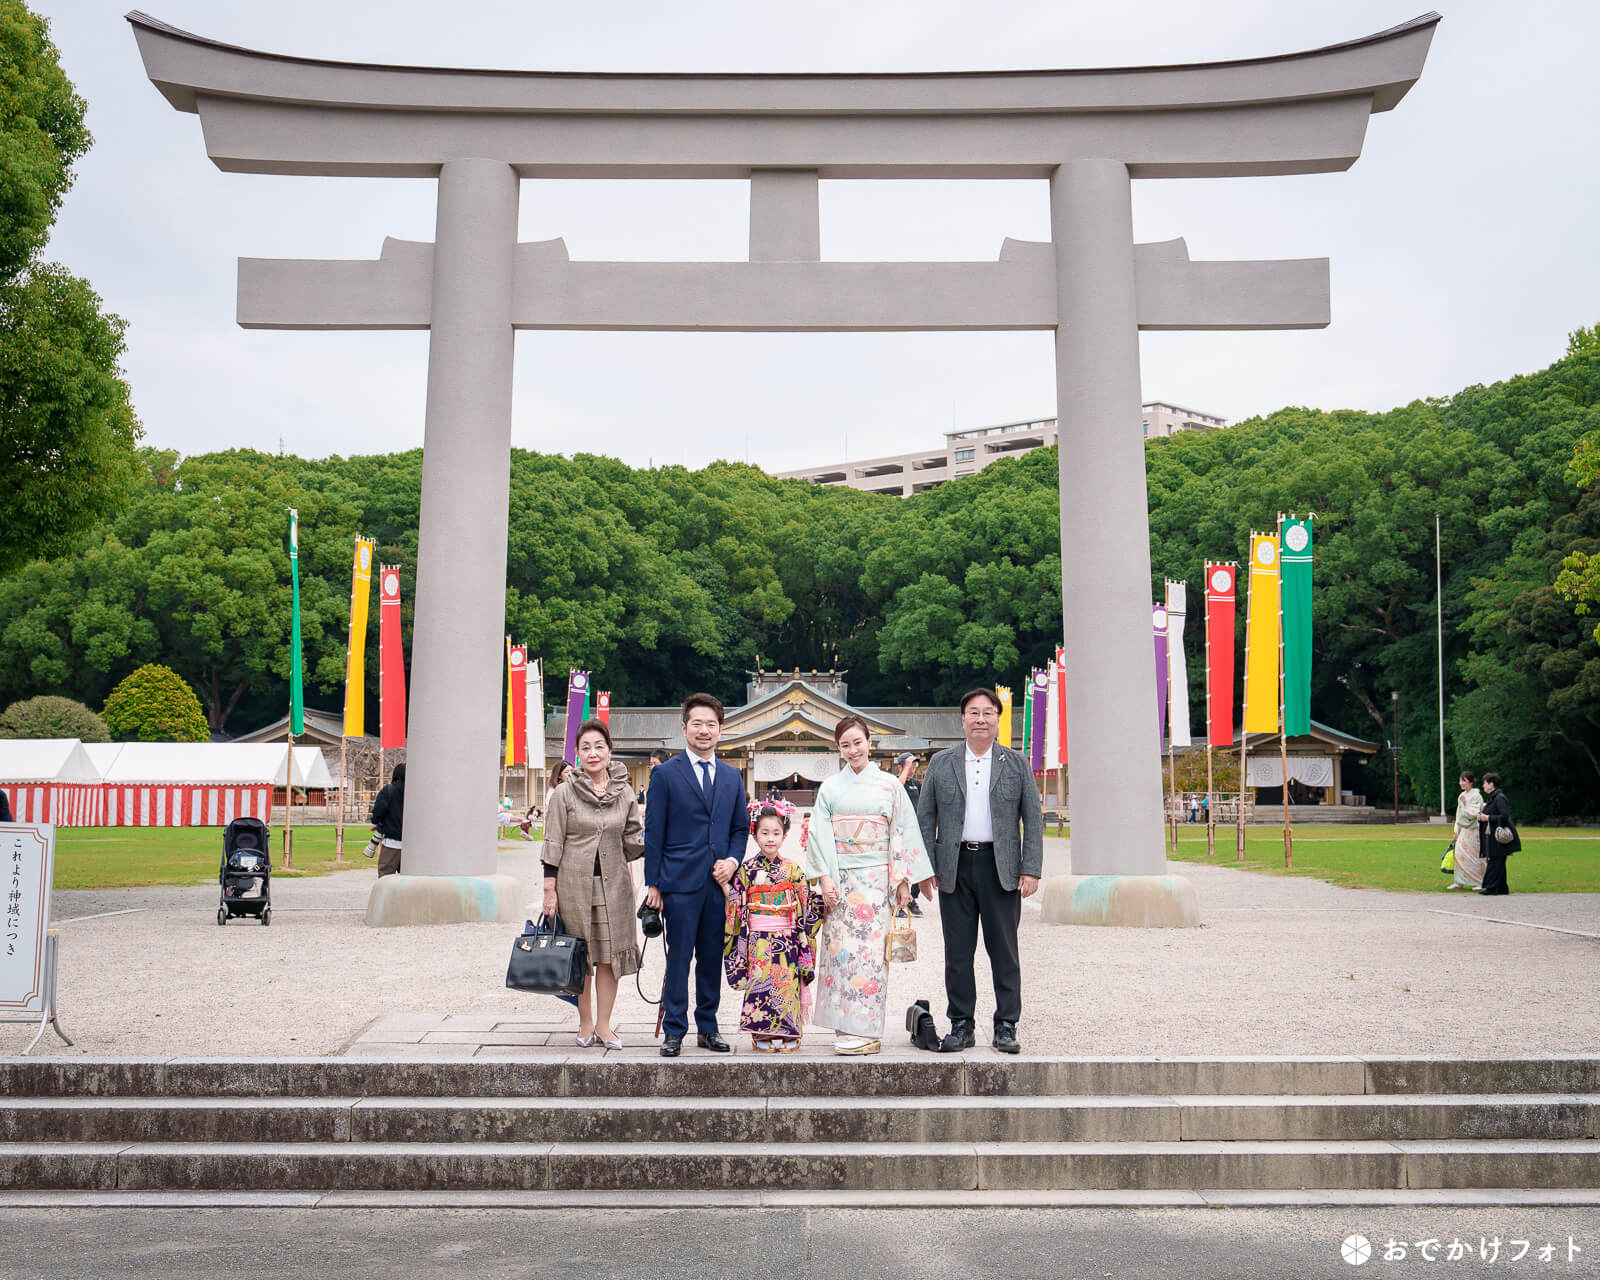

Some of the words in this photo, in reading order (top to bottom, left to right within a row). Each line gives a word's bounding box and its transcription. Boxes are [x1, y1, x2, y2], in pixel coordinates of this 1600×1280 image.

[6, 838, 22, 956] これより神域につき
